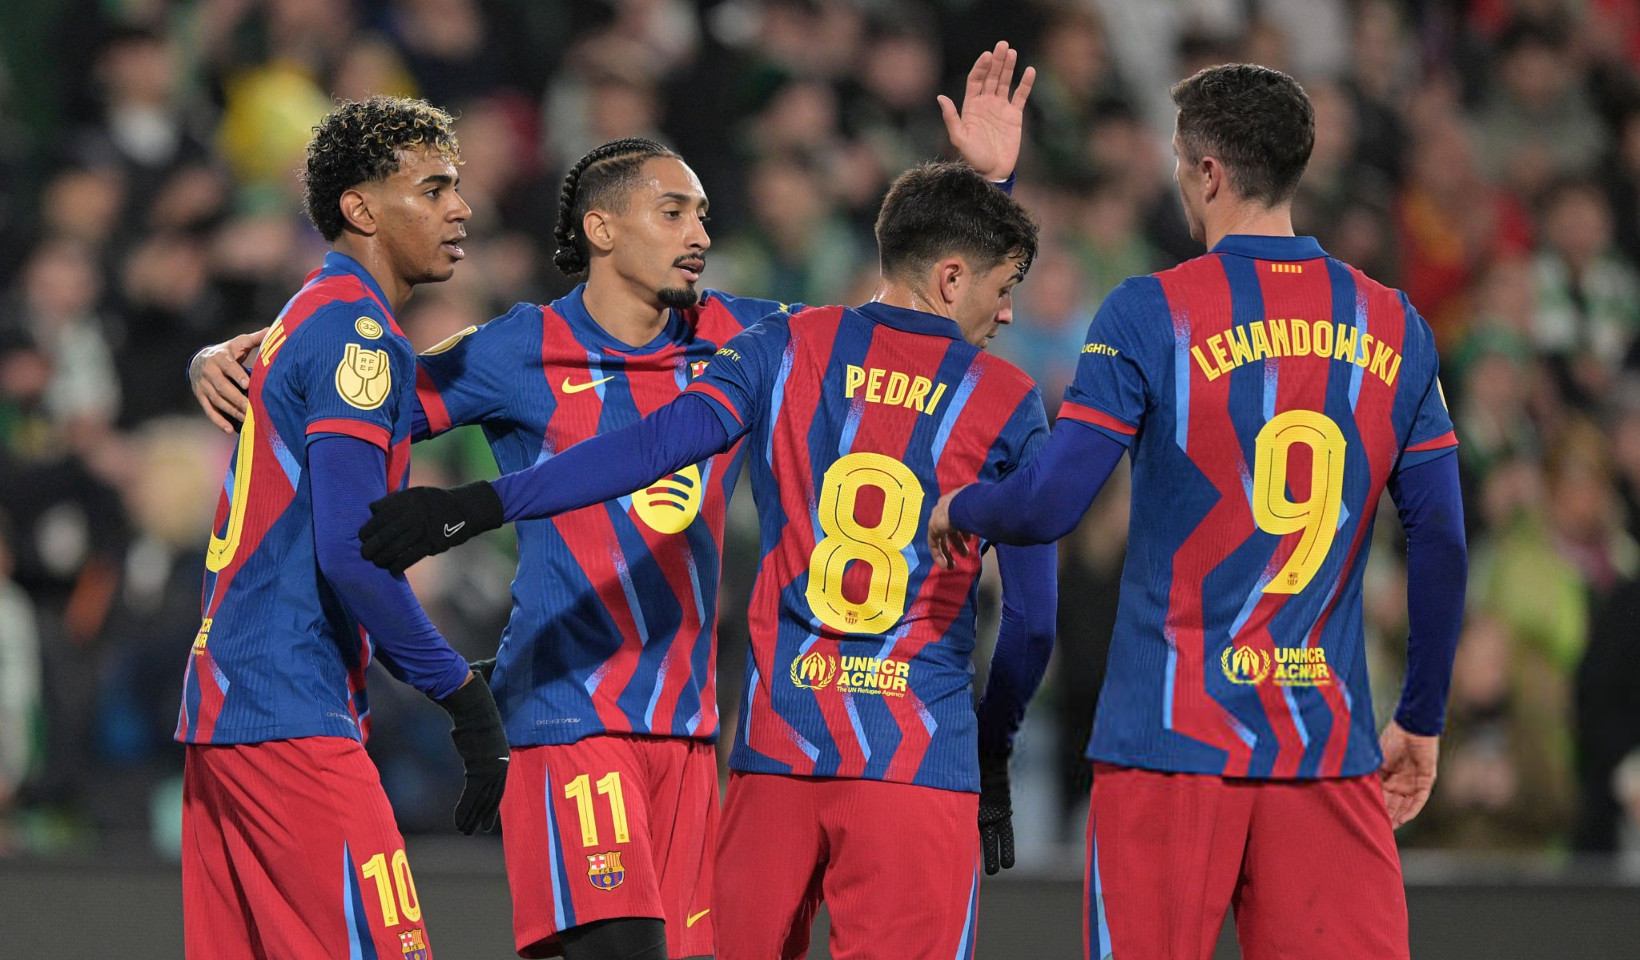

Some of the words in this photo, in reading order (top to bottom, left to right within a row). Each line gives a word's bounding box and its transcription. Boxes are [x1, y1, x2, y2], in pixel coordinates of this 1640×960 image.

[362, 323, 376, 332] 32
[1190, 318, 1402, 387] LEWANDOWSKI
[845, 364, 948, 416] PEDRI
[1252, 409, 1347, 594] 9
[805, 452, 925, 634] 8
[840, 656, 910, 677] UNHCR
[1274, 647, 1326, 664] UNHCR
[1275, 663, 1330, 679] ACNUR
[836, 671, 908, 692] ACNUR
[858, 687, 881, 695] Refugee
[881, 690, 905, 699] Agency
[564, 771, 630, 848] 11
[361, 849, 421, 928] 10
